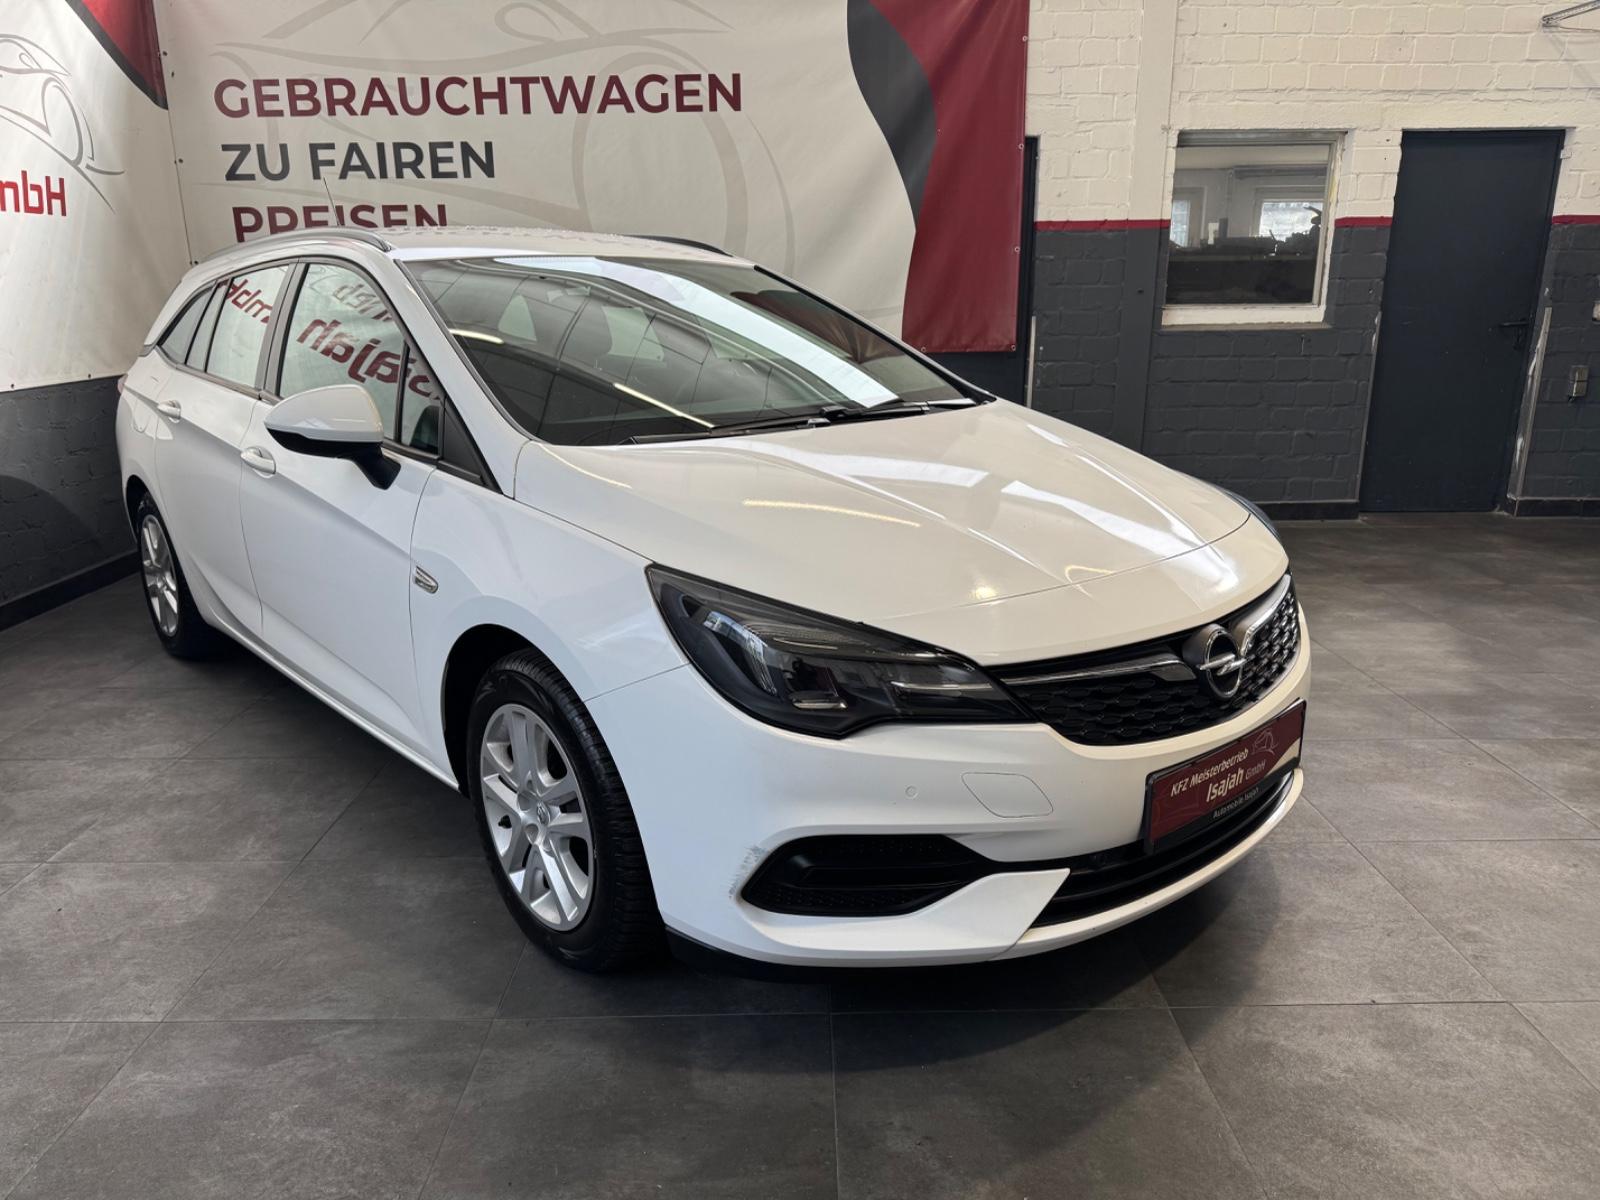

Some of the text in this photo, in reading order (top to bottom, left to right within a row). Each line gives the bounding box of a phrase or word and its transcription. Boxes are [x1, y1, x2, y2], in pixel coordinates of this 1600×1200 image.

[214, 73, 742, 118] GEBRAUCHTWAGEN
[221, 141, 495, 181] ZU FAIREN
[232, 204, 448, 243] PREISEN
[1170, 748, 1249, 797] KFZ Meisterbetrieb
[1206, 767, 1245, 802] Isajah
